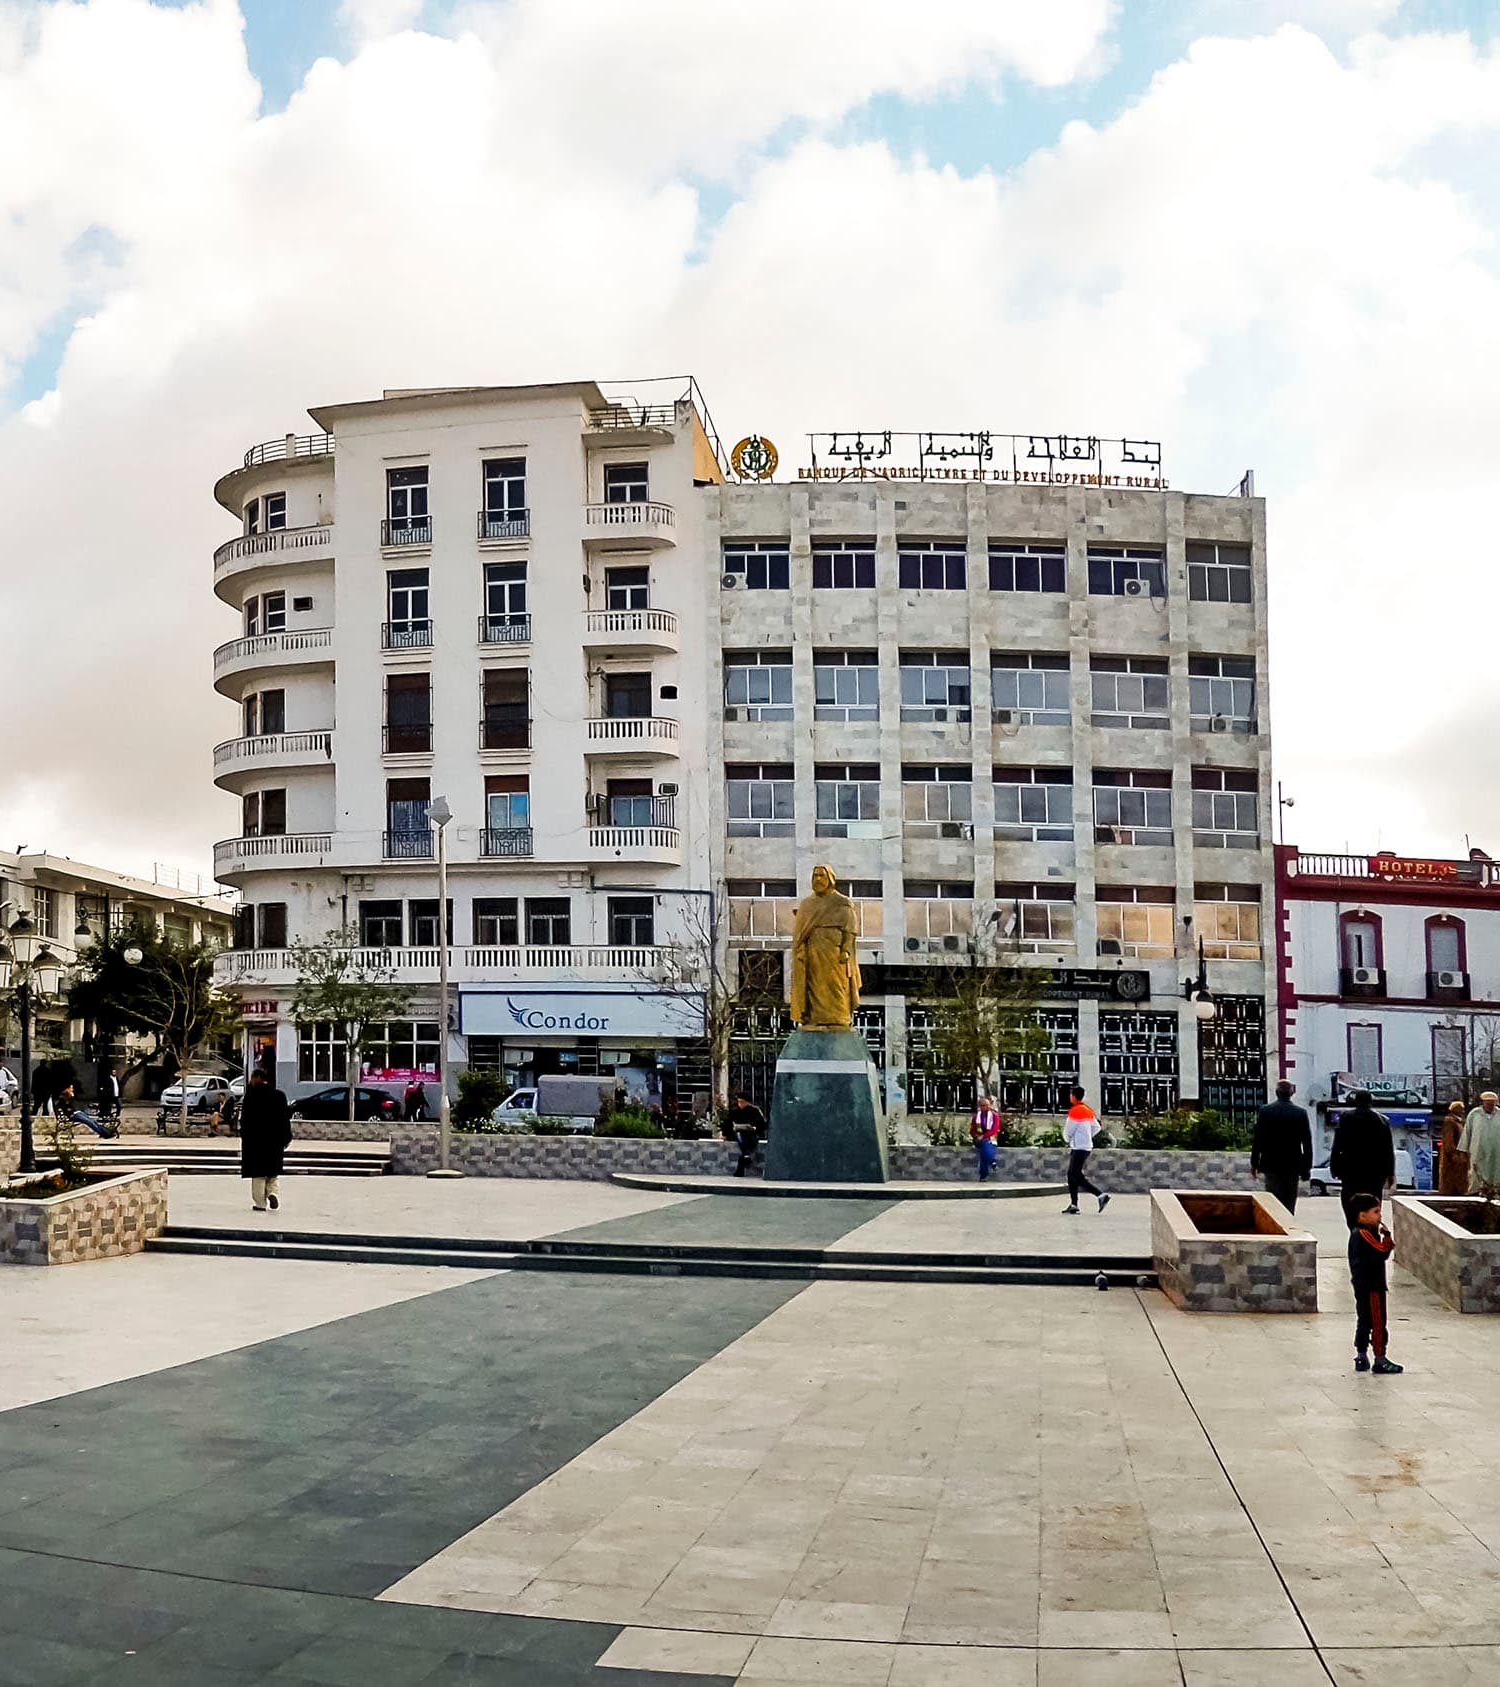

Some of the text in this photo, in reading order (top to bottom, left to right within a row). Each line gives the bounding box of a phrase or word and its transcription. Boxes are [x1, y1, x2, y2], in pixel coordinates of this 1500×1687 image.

[798, 467, 847, 479] BANQUE
[973, 469, 987, 480] ET
[994, 470, 1009, 481] DU
[1126, 476, 1170, 489] RURAL
[1379, 860, 1438, 875] HOTEL
[527, 1010, 609, 1030] Condor
[1366, 1081, 1393, 1091] UNO
